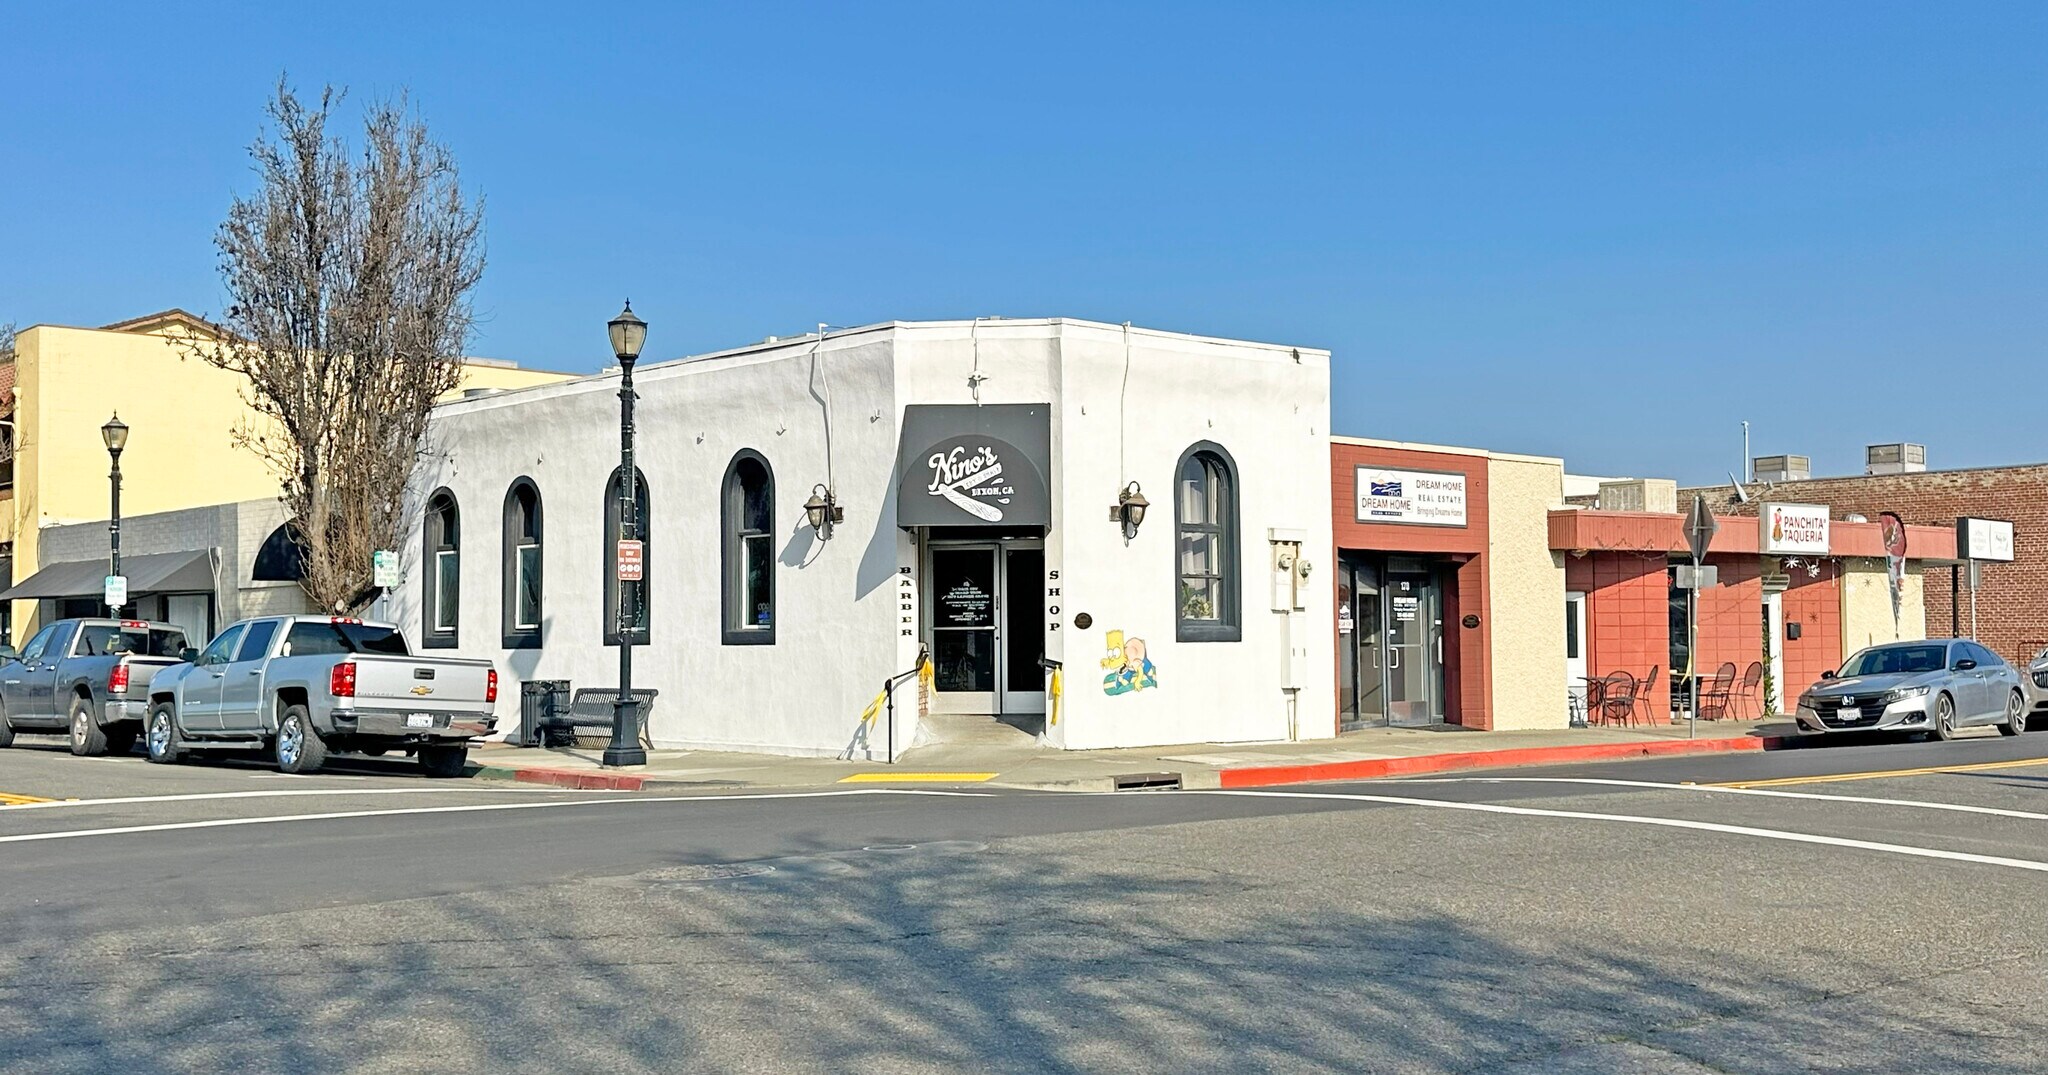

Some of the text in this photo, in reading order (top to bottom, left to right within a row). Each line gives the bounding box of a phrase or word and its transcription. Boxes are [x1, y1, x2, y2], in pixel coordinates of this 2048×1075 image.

[928, 446, 998, 491] Nino's
[1416, 480, 1462, 491] DREAM HOME
[1361, 497, 1411, 511] DREAM HOME
[1418, 494, 1462, 504] REAL ESTATE
[1784, 529, 1823, 544] TAQUERIA
[900, 566, 912, 635] BARBER
[1048, 570, 1060, 631] SHOP
